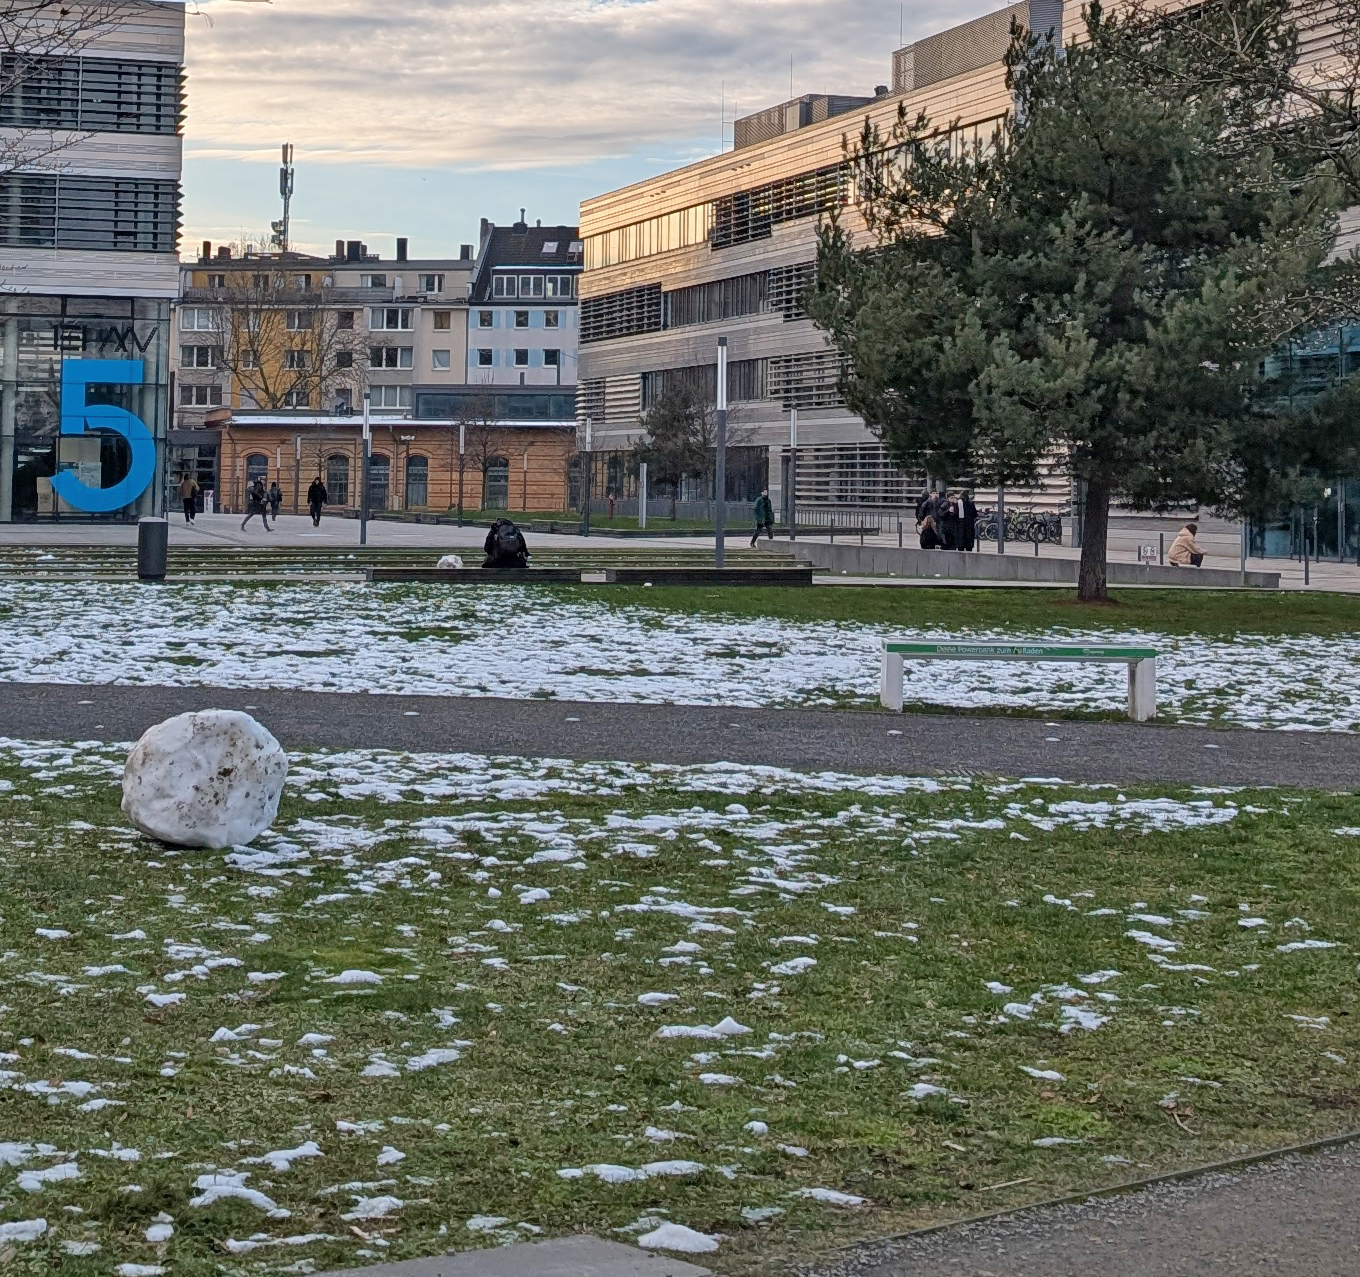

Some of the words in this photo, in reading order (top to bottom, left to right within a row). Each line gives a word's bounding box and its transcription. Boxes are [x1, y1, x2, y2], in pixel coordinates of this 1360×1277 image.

[49, 359, 157, 513] 5
[936, 645, 957, 653] Deine
[957, 646, 995, 654] Powerbank
